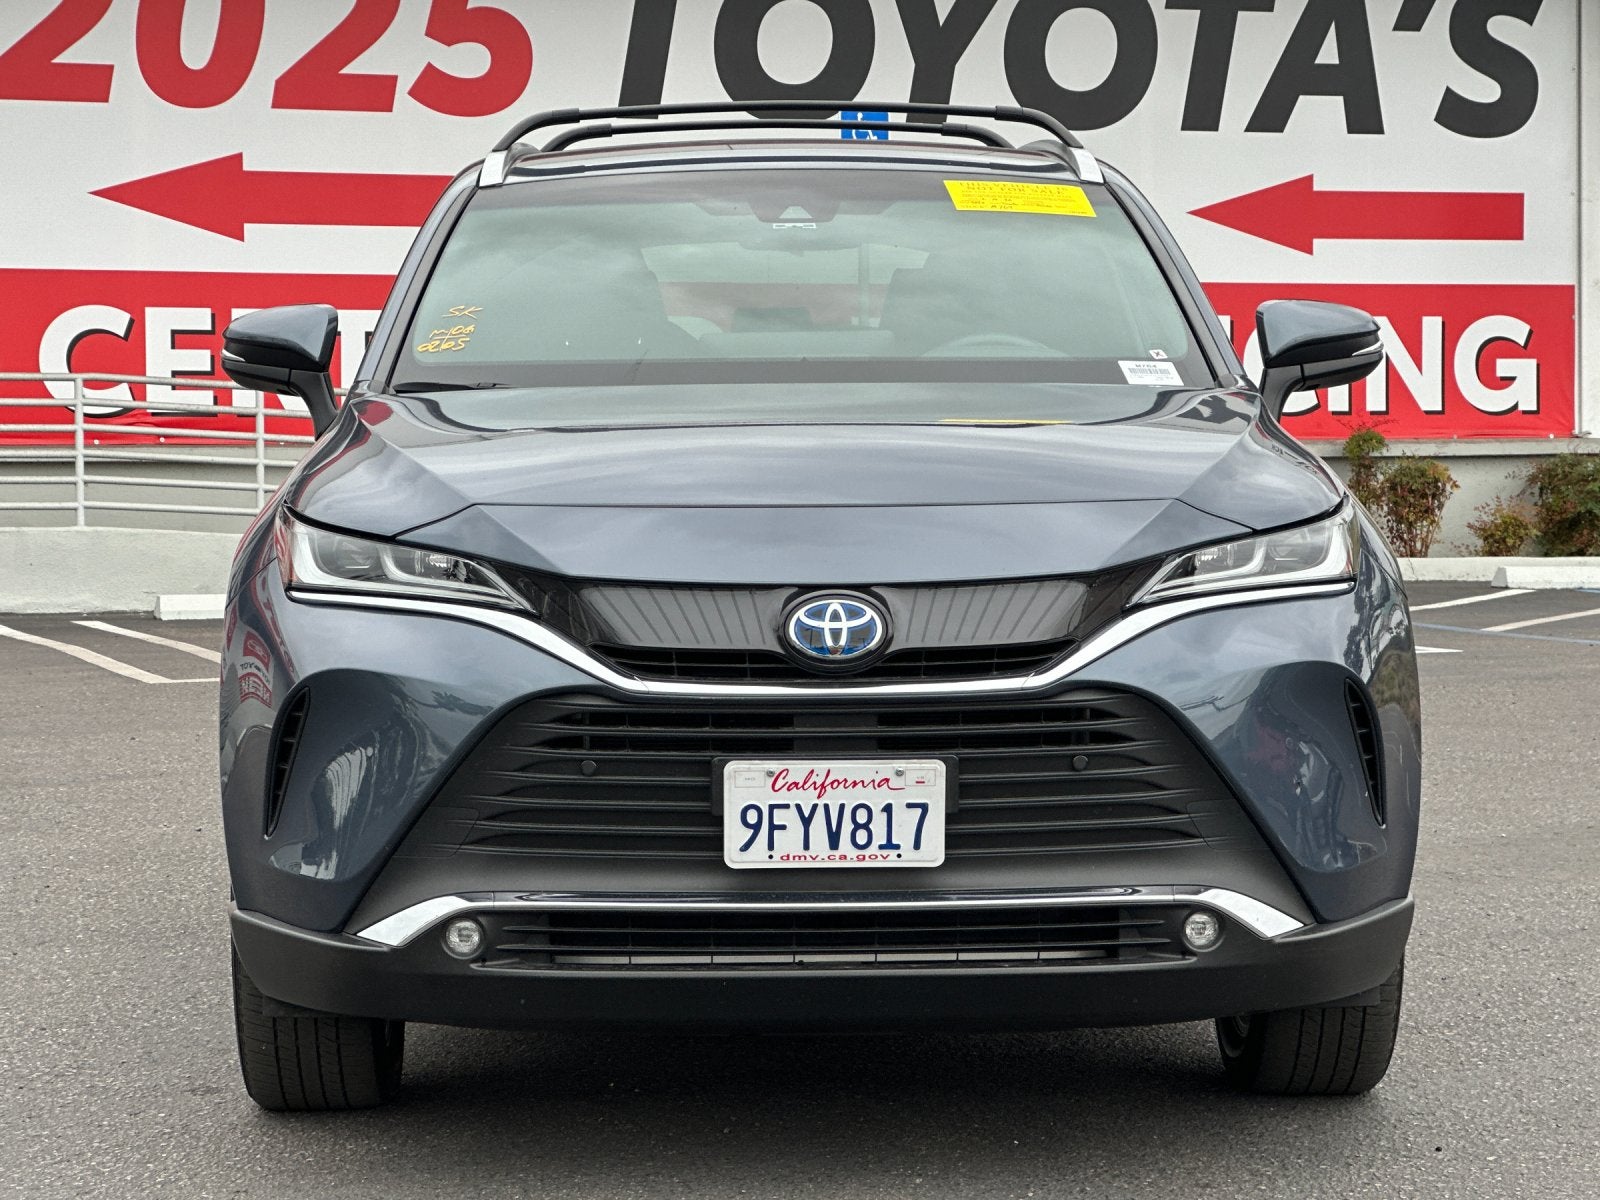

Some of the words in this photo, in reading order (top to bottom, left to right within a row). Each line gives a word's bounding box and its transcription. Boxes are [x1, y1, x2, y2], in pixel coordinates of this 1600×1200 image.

[0, 0, 533, 117] 2025
[771, 768, 906, 799] California
[738, 802, 930, 853] 9FYV817
[779, 853, 891, 862] dmv.ca.gov
